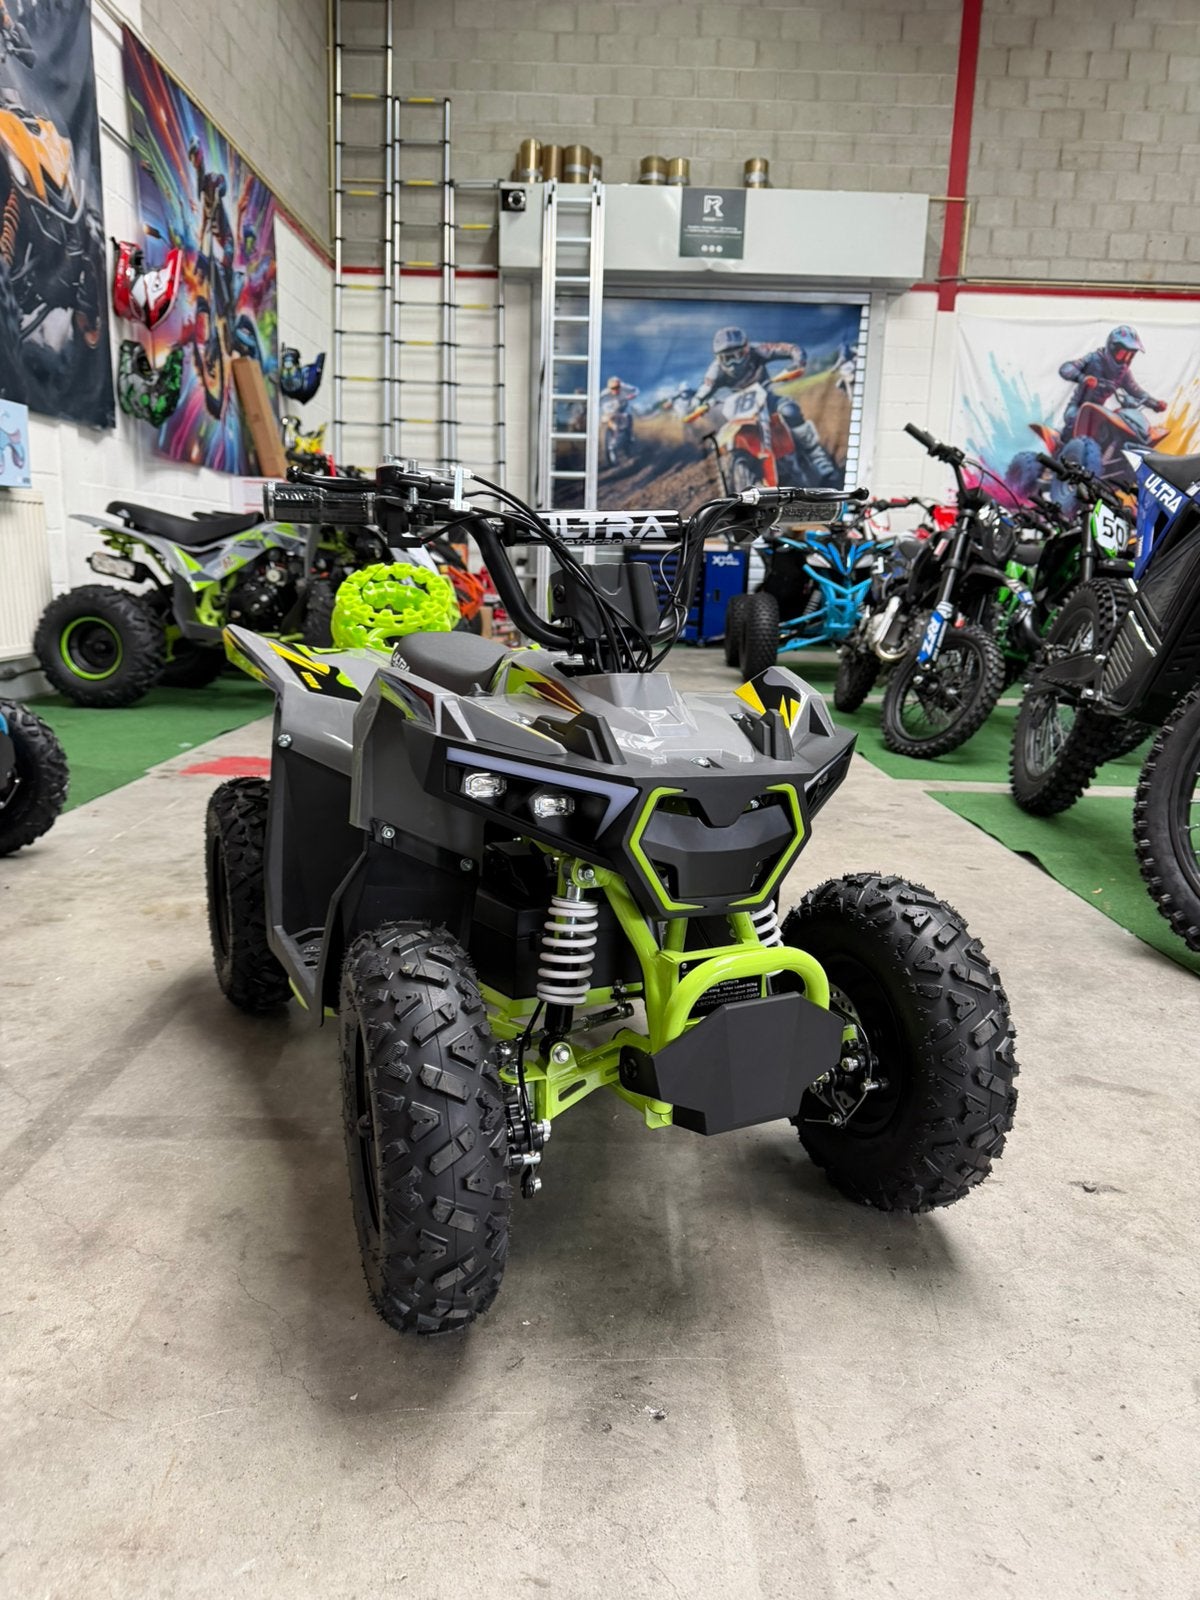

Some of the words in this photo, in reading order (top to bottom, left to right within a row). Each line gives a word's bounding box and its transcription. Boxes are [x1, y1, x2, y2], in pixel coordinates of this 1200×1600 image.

[1144, 473, 1183, 513] ULTRA
[559, 538, 642, 546] OTOCROSS
[1102, 515, 1125, 549] 50
